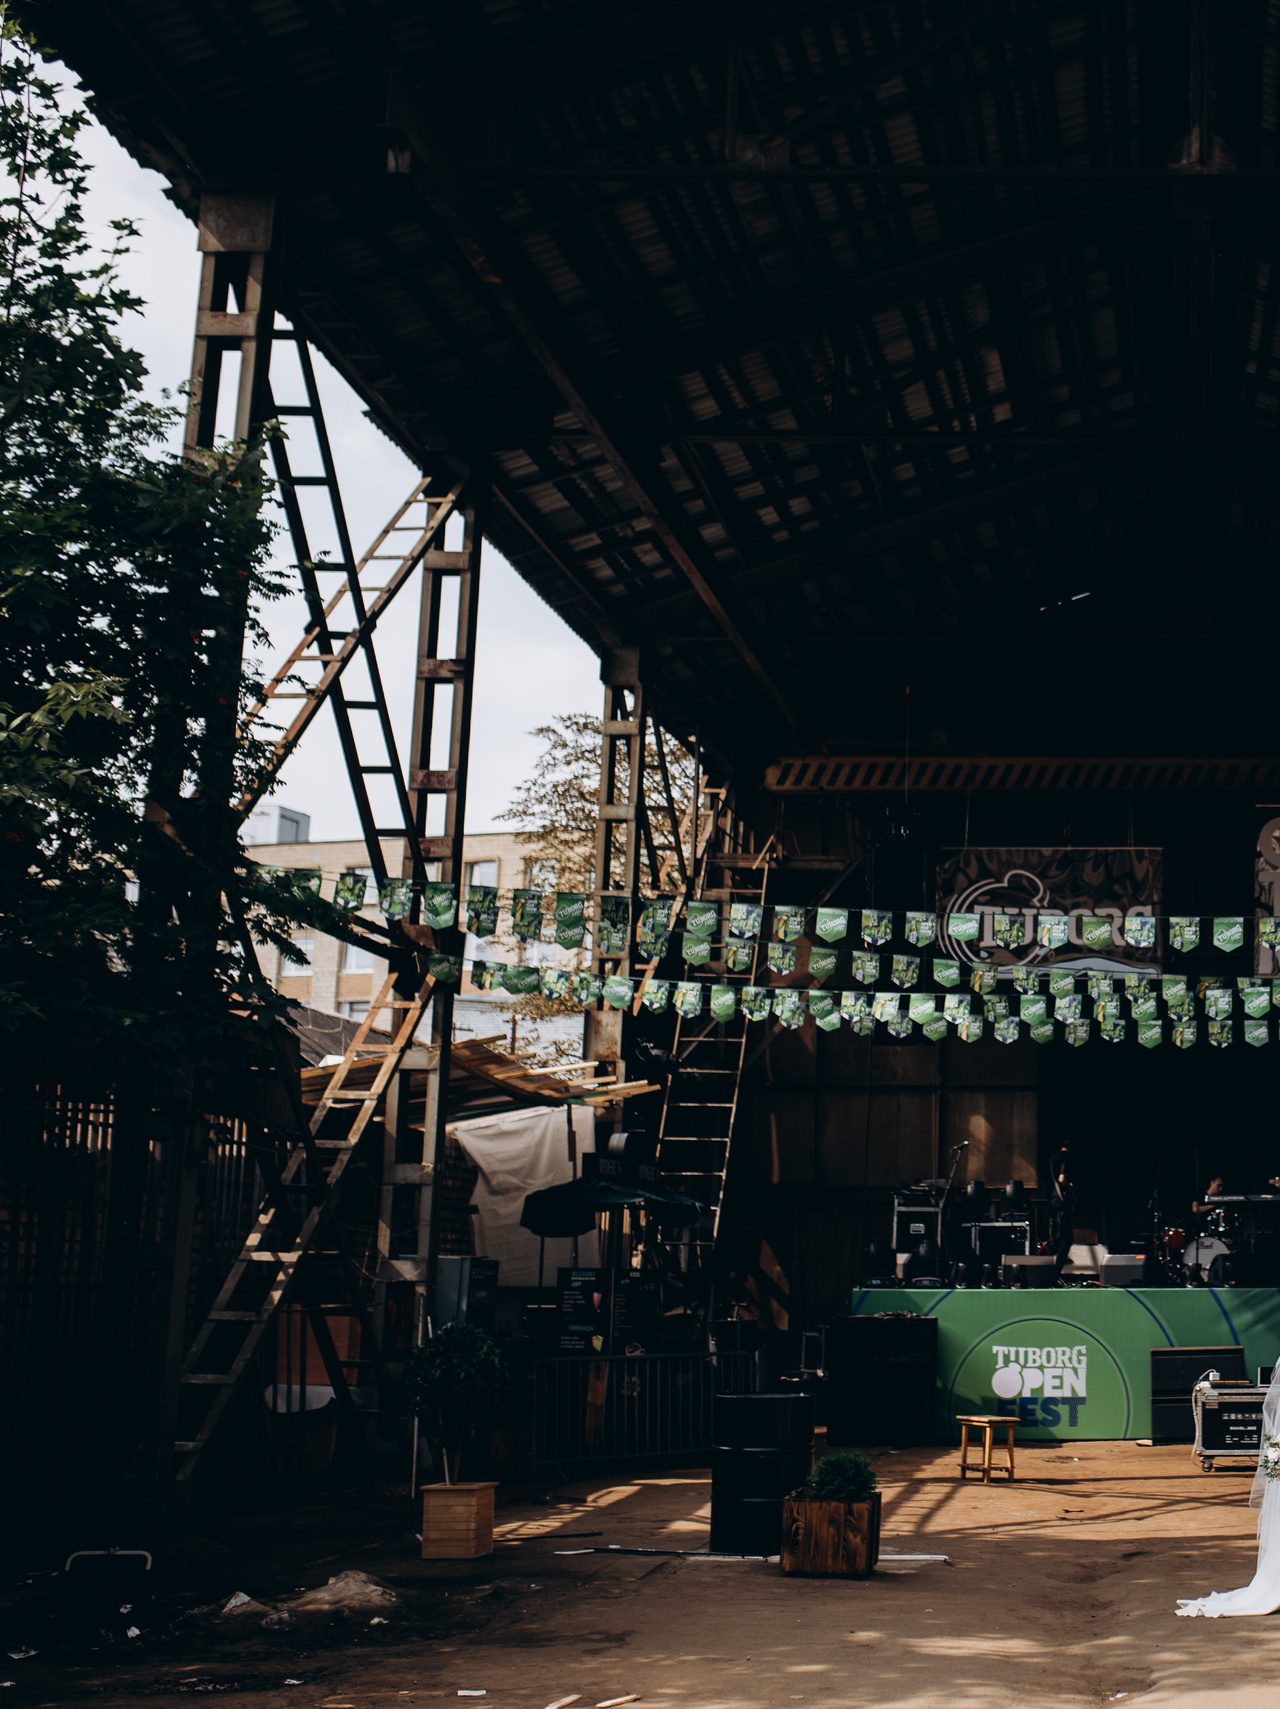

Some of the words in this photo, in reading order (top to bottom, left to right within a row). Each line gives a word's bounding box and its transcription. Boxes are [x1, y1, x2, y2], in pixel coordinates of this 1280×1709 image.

[559, 901, 584, 917] TUBORG
[691, 910, 717, 926] TUBORG
[820, 917, 846, 931] TUBORG
[559, 927, 584, 940] TUBORG
[952, 921, 978, 933] TUBORG
[1086, 924, 1111, 942] TUBORG
[1217, 924, 1241, 942] TUBORG
[686, 942, 709, 955] TUBORG
[812, 956, 836, 970] TUBORG
[1053, 976, 1075, 990] TUBORG
[1165, 982, 1186, 997] TUBORG
[1022, 1001, 1045, 1015] TUBORG
[1134, 1000, 1156, 1015] TUBORG
[1247, 994, 1268, 1009] TUBORG
[992, 1345, 1087, 1368] TUBORG
[991, 1362, 1087, 1398] OPEN
[998, 1397, 1086, 1428] FEST
